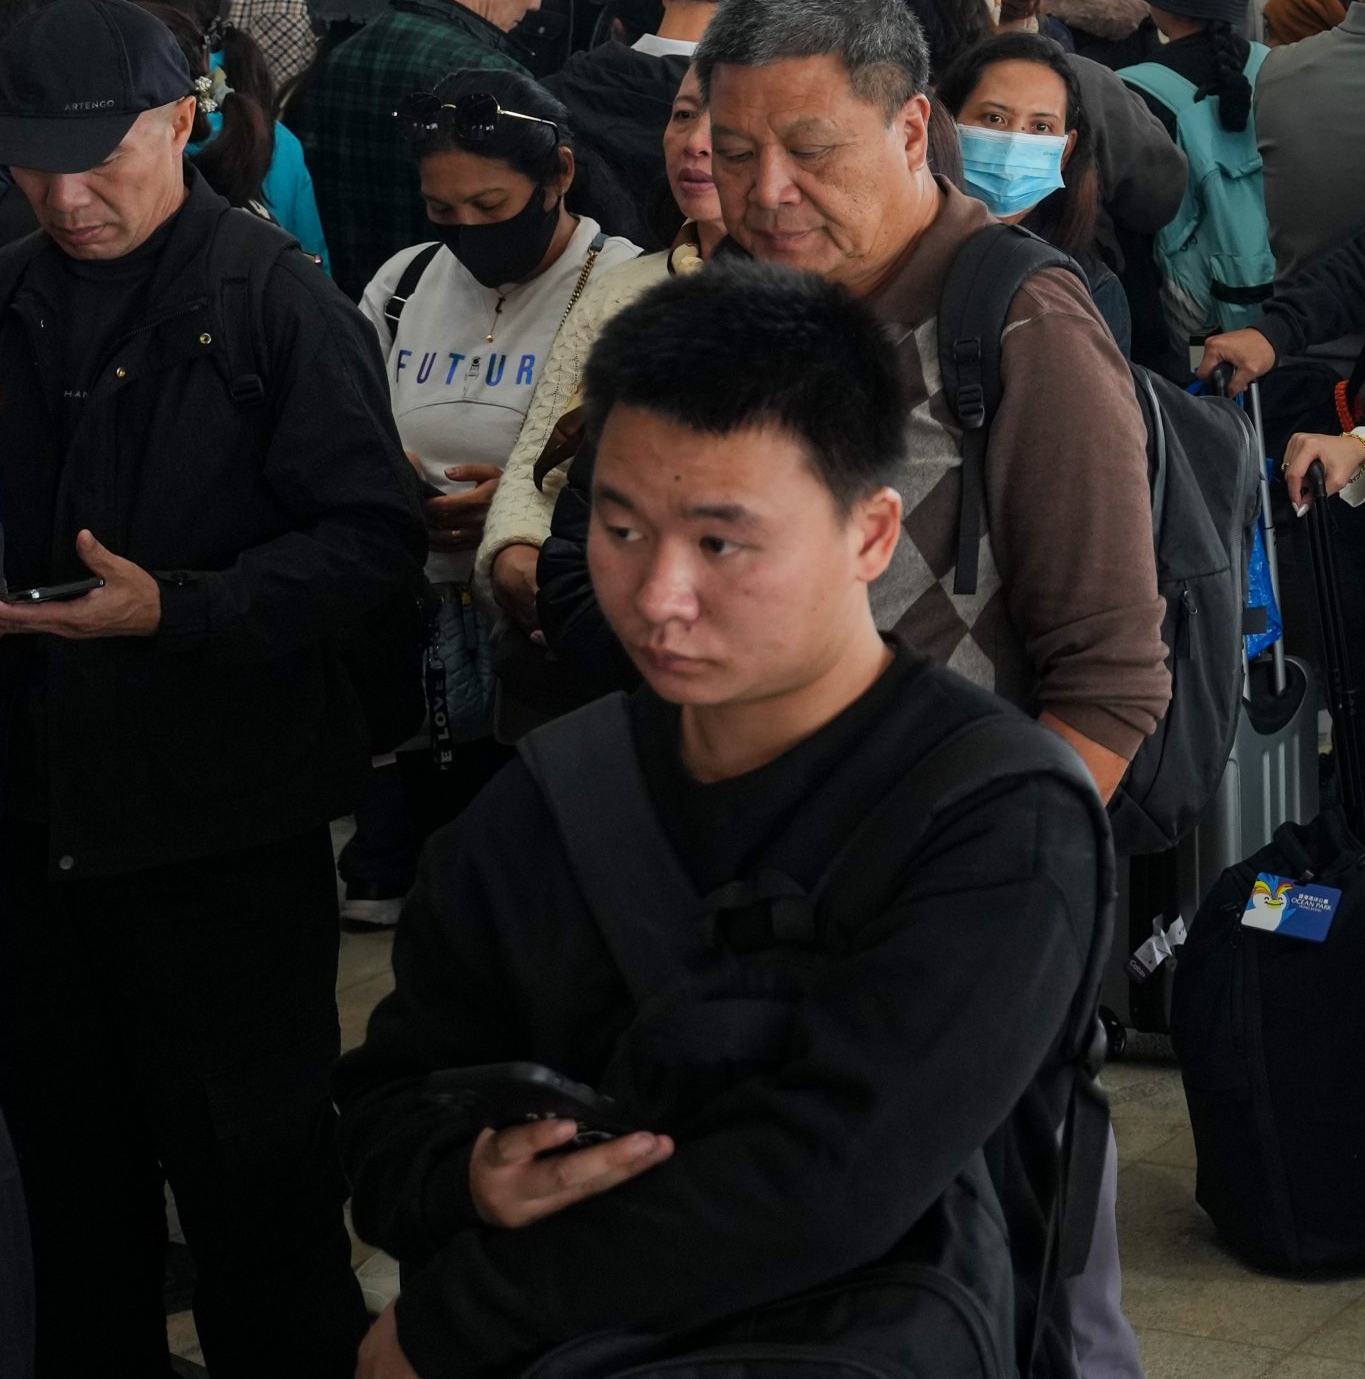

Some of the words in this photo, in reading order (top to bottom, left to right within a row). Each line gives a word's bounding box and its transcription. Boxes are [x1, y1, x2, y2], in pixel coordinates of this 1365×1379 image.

[63, 99, 115, 111] ARTENGO
[434, 679, 450, 740] LOVE
[1291, 897, 1316, 907] OCEAN
[1315, 902, 1332, 911] PARK
